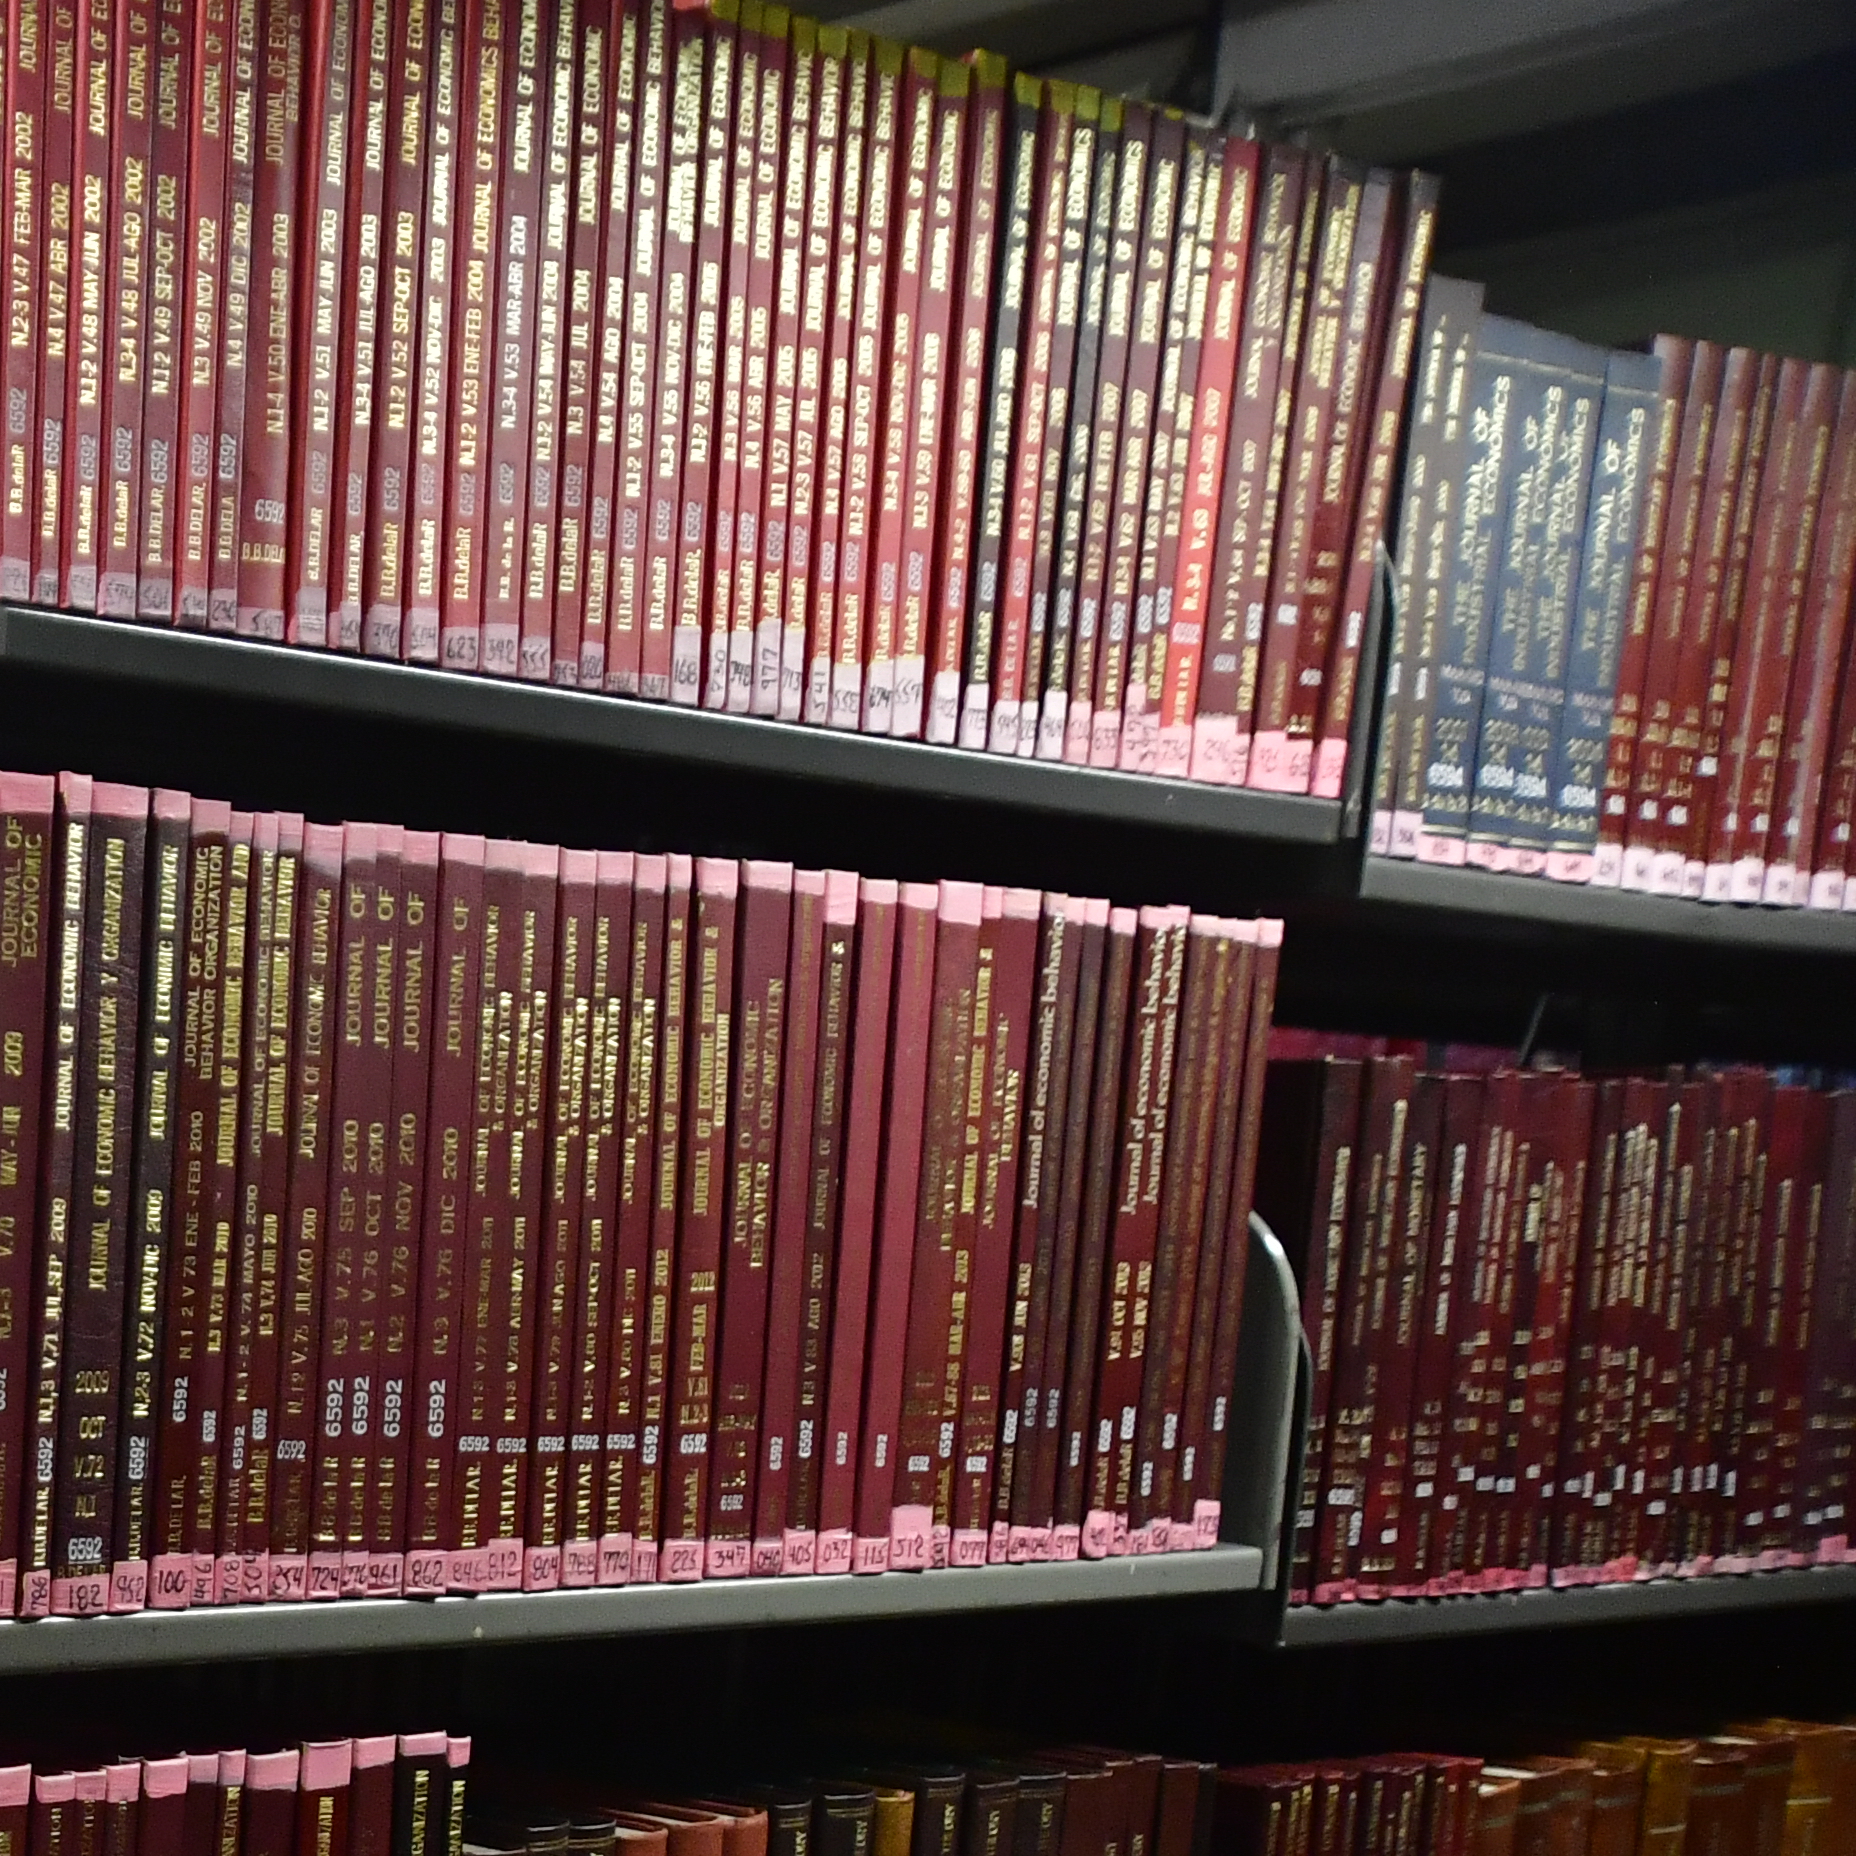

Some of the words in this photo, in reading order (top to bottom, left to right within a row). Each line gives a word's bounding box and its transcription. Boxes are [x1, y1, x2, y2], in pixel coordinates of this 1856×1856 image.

[56, 6, 73, 28] OF
[161, 22, 180, 45] OF
[204, 33, 222, 54] OF
[54, 40, 72, 114] JOURNAL
[159, 53, 179, 129] JOURNAL
[202, 62, 221, 137] JOURNAL
[16, 112, 33, 159] 2002
[14, 168, 32, 245] FEB-MAR
[51, 182, 68, 229] 2002
[158, 175, 176, 220] 2002
[50, 238, 66, 273] ABR
[199, 218, 217, 263] 2002
[510, 215, 527, 255] 2004
[14, 253, 30, 293] V.47
[155, 230, 174, 300] SEP-OCT
[468, 260, 485, 302] 2004
[49, 281, 65, 319] V.47
[196, 270, 213, 307] NOV
[506, 263, 525, 336] MAR-ABR
[155, 307, 171, 345] V.49
[195, 312, 212, 349] V.49
[465, 309, 482, 373] ENE-FEB
[503, 343, 520, 379] V.53
[10, 388, 26, 434] 6592
[460, 379, 478, 415] V.53
[45, 418, 61, 465] 6592
[1471, 407, 1491, 446] OF
[1481, 376, 1510, 515] ECONOMICS
[151, 439, 168, 484] 6592
[192, 433, 209, 477] 6592
[1600, 441, 1622, 477] OF
[1617, 408, 1645, 542] ECONOMICS
[460, 473, 476, 516] 6592
[1459, 458, 1486, 561] JOURNAL
[1588, 488, 1616, 590] JOURNAL
[64, 823, 84, 910] BEHAVIOR
[160, 845, 179, 931] BEHAVIOR
[191, 847, 208, 943] ECONOMIC
[204, 846, 223, 980] ORGANIZATION
[350, 883, 366, 918] OF
[60, 920, 79, 1009] ECONOMIC
[189, 951, 202, 976] OF
[346, 937, 365, 1047] JOURNAL
[58, 1021, 74, 1044] OF
[152, 1033, 170, 1056] OF
[185, 986, 201, 1067] JOURNAL
[201, 989, 217, 1079] BEHAVIOR
[54, 1056, 74, 1131] JOURNAL
[149, 1069, 168, 1141] JOURNAL
[189, 1111, 204, 1151] 2010
[342, 1119, 360, 1174] 2010
[49, 1198, 66, 1242] 2009
[145, 1190, 164, 1233] 2009
[339, 1187, 356, 1232] SEP
[335, 1247, 353, 1300] V.75
[136, 1323, 154, 1361] V.72
[173, 1376, 189, 1422] 6592
[325, 1378, 345, 1437] 6592
[38, 1437, 53, 1482] 6592
[129, 1436, 146, 1479] 6592
[68, 1538, 103, 1561] 6592
[68, 1579, 104, 1609] 182
[411, 1562, 444, 1588] 862
